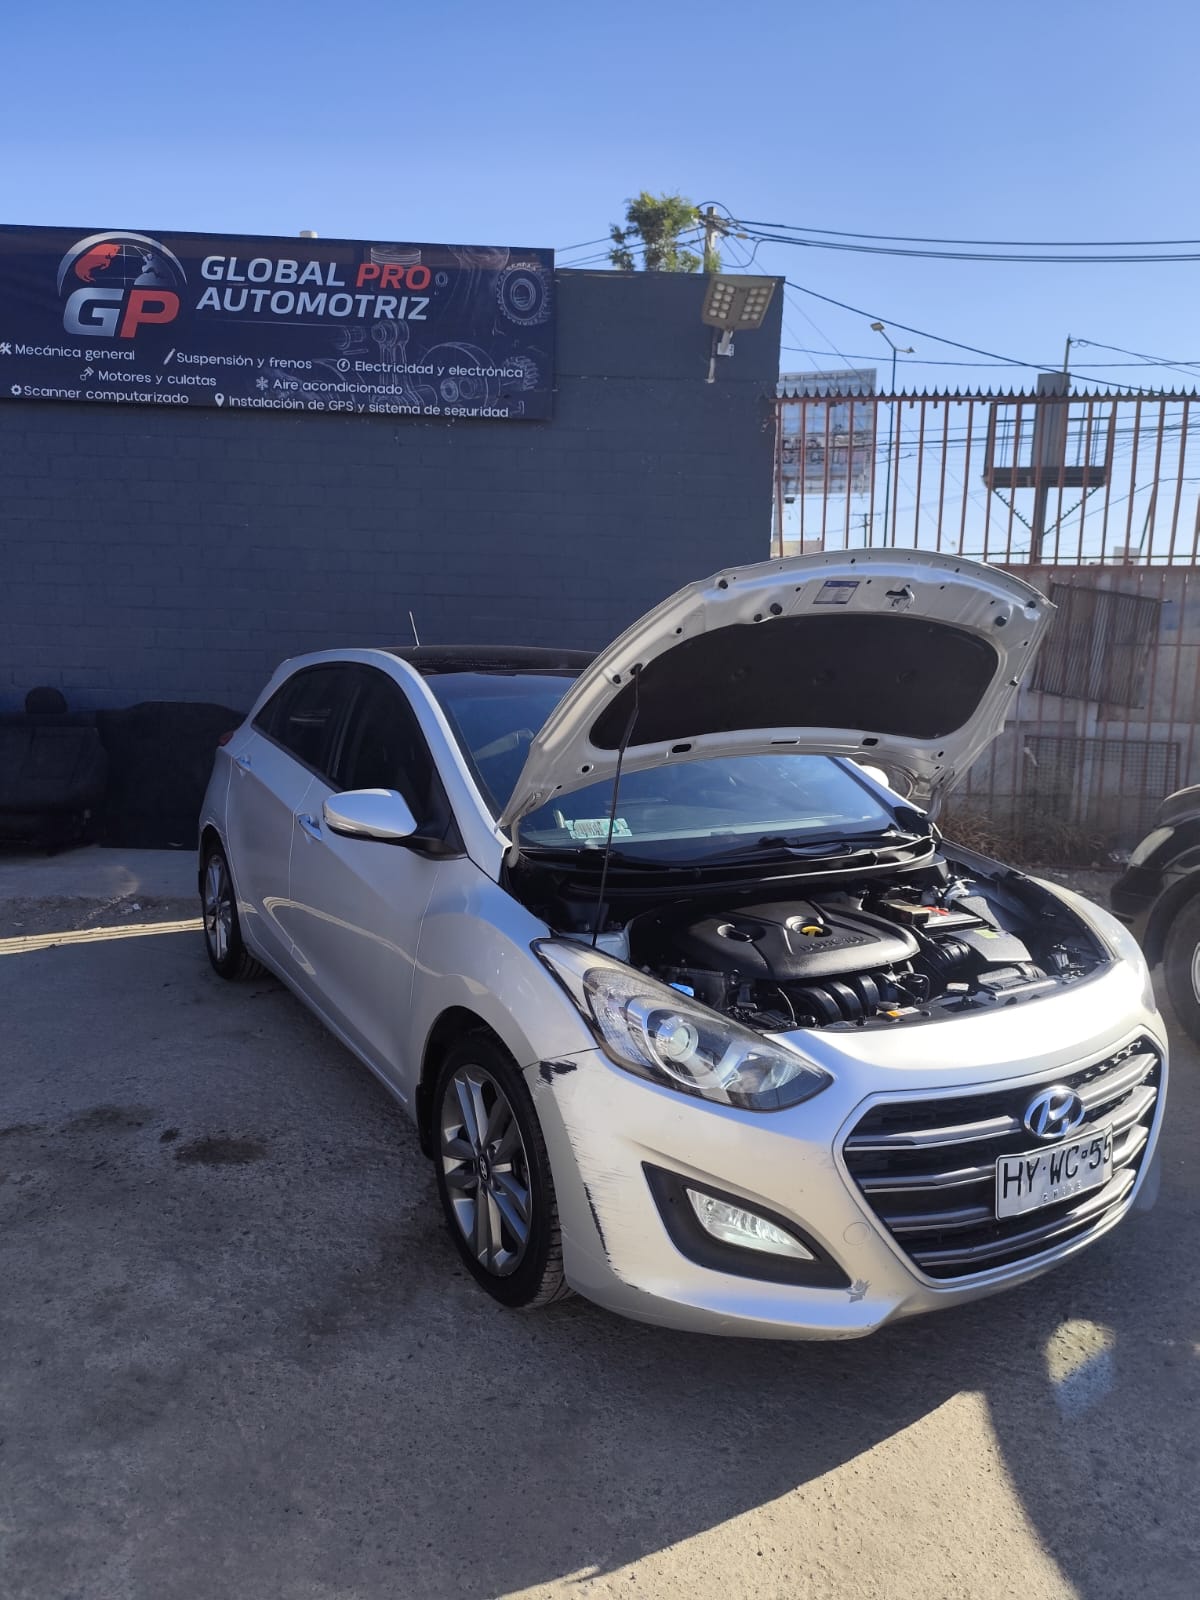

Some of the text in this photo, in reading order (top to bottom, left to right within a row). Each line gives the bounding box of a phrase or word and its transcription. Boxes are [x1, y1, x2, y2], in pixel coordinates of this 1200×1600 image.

[200, 256, 432, 290] GLOBAL PRO
[196, 286, 430, 321] AUTOMOTRIZ
[63, 287, 180, 339] GP
[15, 344, 135, 361] Mecánica general
[176, 352, 312, 369] Suspensión y frenos
[98, 370, 217, 386] Motores y culatas
[355, 360, 523, 378] Electricidad y electrónica
[24, 386, 189, 404] Scanner computarizado
[273, 379, 403, 395] Aire acondicionado
[307, 399, 324, 410] de
[328, 400, 354, 412] GPS
[358, 403, 365, 413] y
[369, 402, 420, 415] sistema
[424, 403, 440, 415] de
[445, 406, 509, 418] seguridad
